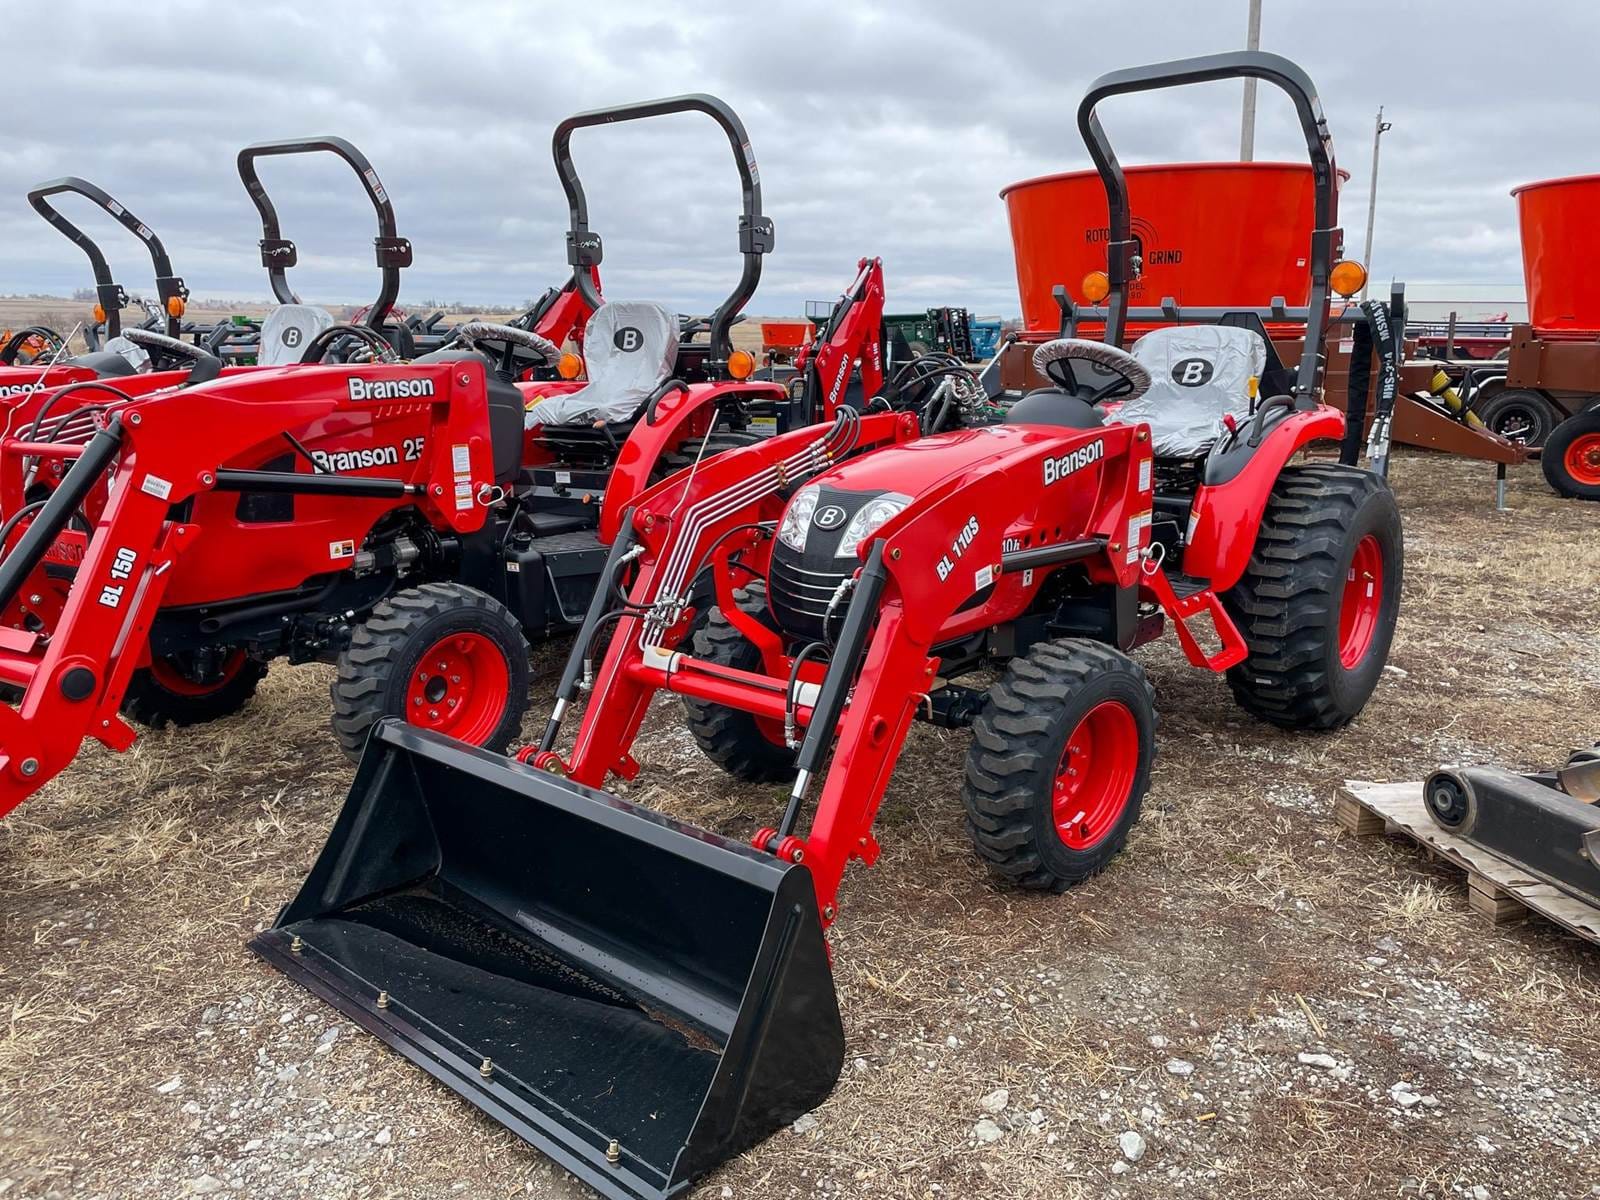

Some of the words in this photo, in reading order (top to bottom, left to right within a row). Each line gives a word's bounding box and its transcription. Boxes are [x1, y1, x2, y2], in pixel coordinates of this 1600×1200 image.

[1085, 228, 1110, 243] ROTO
[1149, 250, 1183, 264] GRIND
[622, 330, 638, 350] B
[829, 353, 849, 404] Branson
[1181, 361, 1205, 384] B
[349, 377, 434, 400] Branson
[311, 445, 397, 475] Branson
[403, 437, 425, 461] 25
[1043, 438, 1105, 487] Branson
[936, 555, 955, 582] BL
[952, 515, 980, 558] 110S
[98, 586, 124, 608] BL
[111, 547, 137, 579] 150
